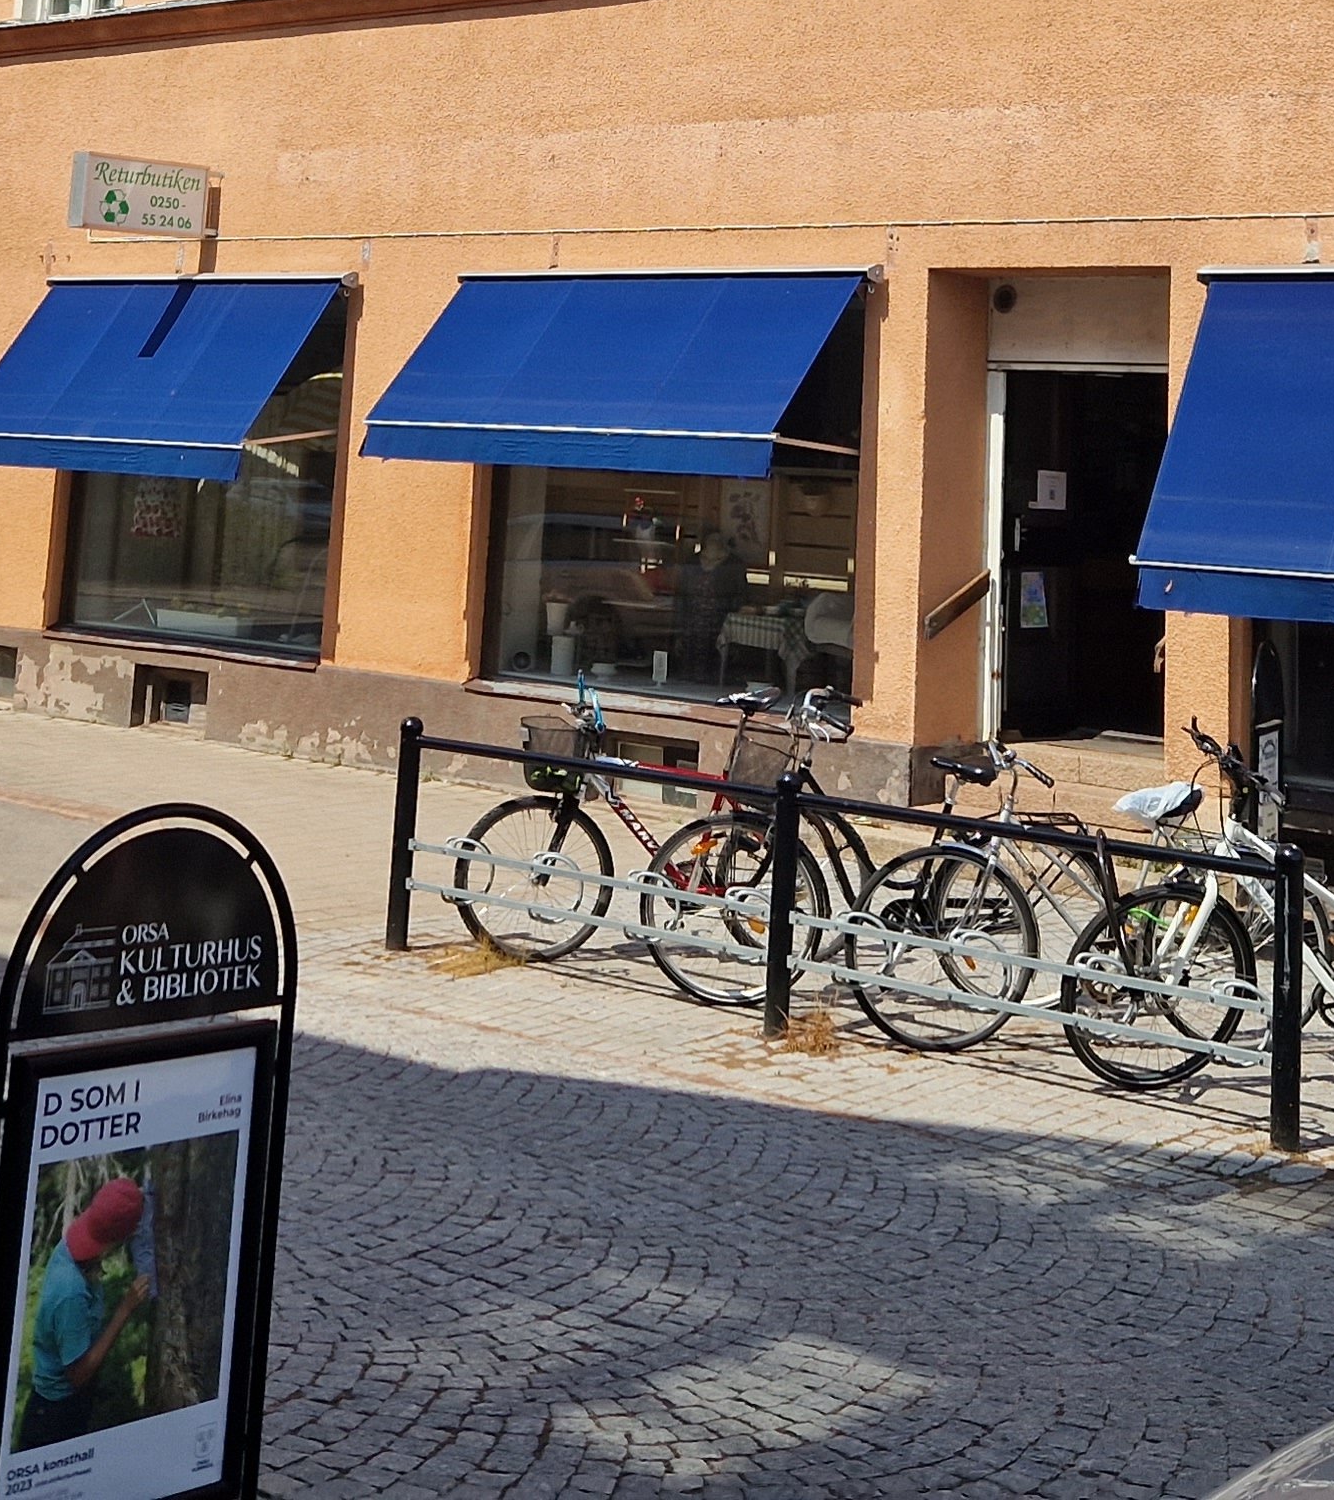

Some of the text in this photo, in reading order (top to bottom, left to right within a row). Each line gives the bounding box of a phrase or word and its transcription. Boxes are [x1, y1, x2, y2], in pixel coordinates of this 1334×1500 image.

[94, 161, 202, 194] Returbutiken
[141, 213, 192, 229] 55 24 06
[121, 922, 170, 946] ORSA
[119, 934, 263, 976] KULTURHUS
[116, 963, 261, 1006] & BIBLIOTEK
[43, 1079, 141, 1117] D SOM I
[219, 1093, 242, 1107] Elina
[40, 1111, 142, 1150] DOTTER
[198, 1106, 242, 1124] Birkehag
[6, 1463, 41, 1481] ORSA
[42, 1447, 95, 1473] konsthall
[5, 1478, 33, 1497] 2023
